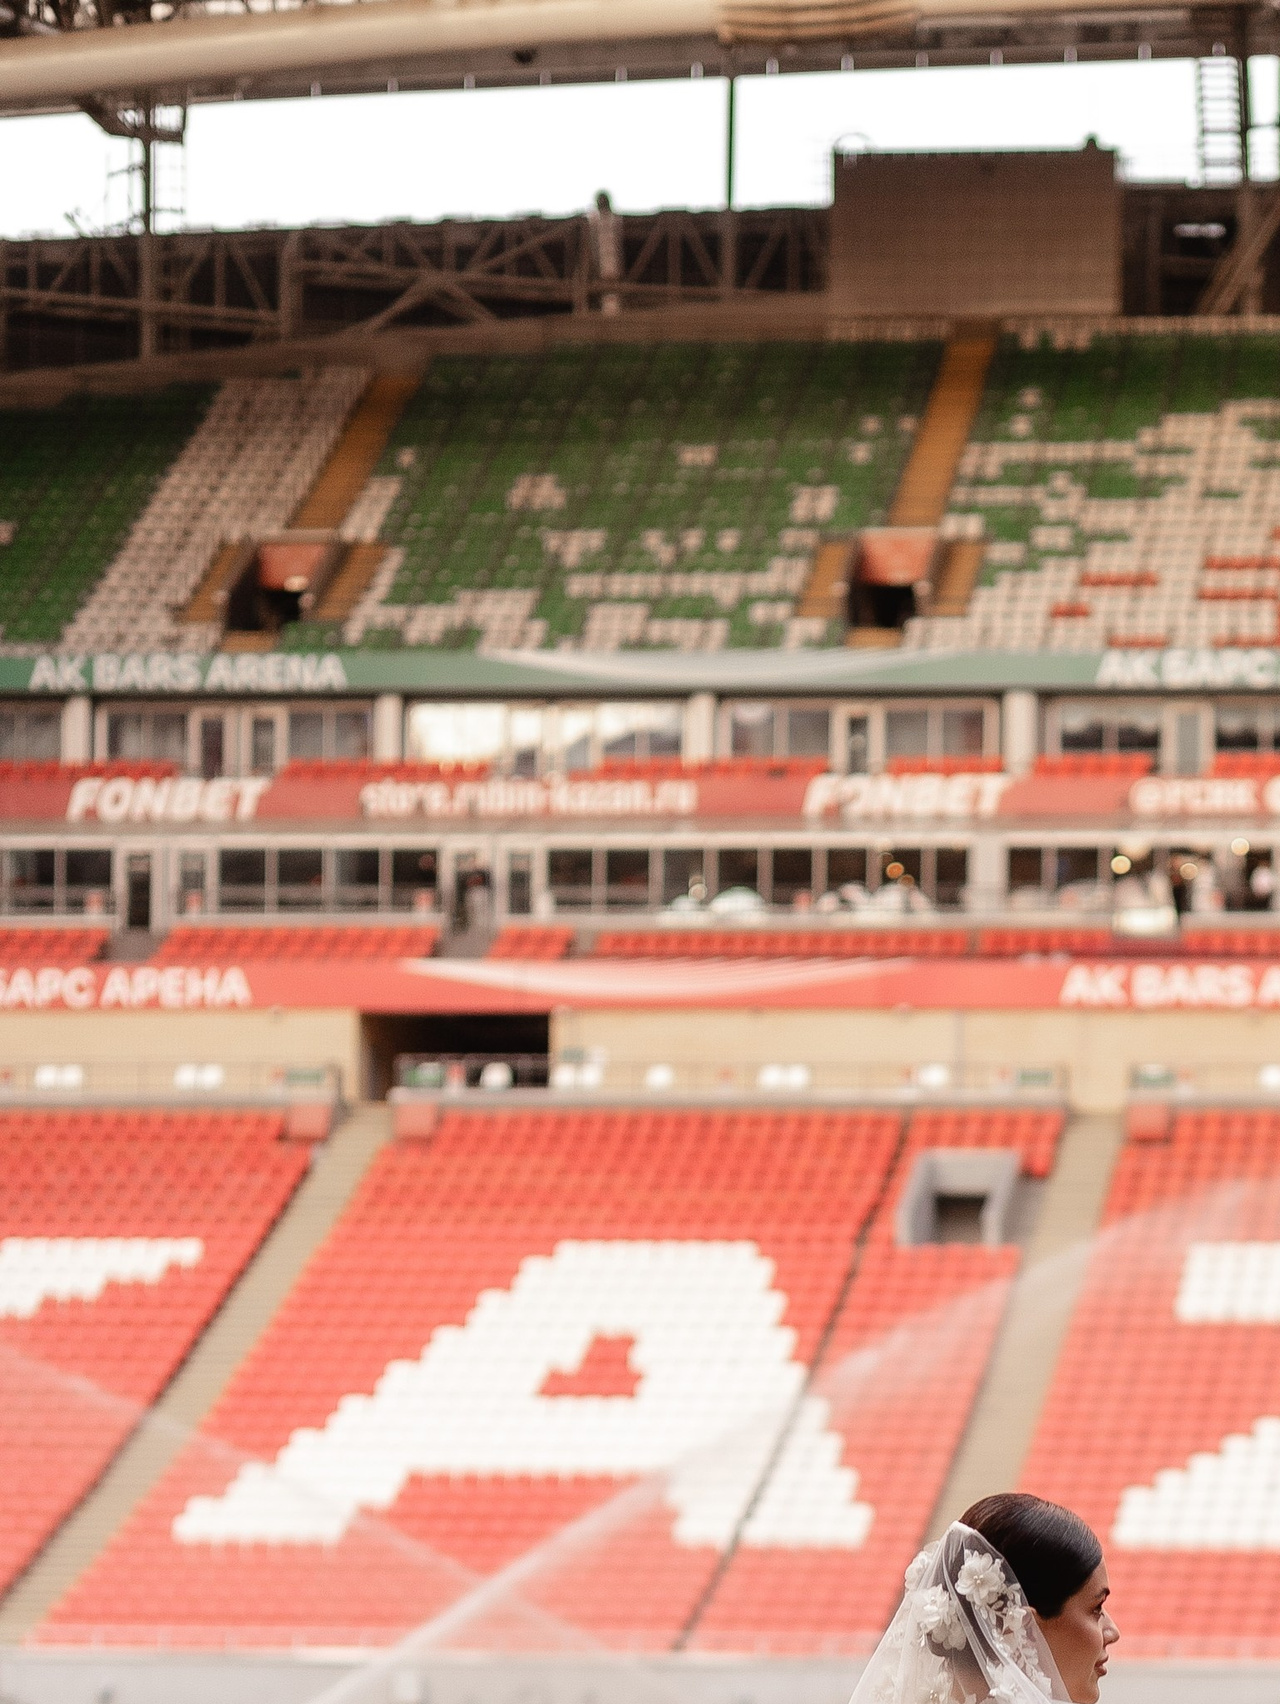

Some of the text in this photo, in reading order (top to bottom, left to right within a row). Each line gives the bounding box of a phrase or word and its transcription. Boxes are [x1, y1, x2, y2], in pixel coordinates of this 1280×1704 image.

[29, 654, 348, 692] AK BARS ARENA
[66, 776, 271, 822] FONBET
[0, 966, 251, 1008] АРС АРЕНА
[1060, 964, 1128, 1007] AK
[1129, 964, 1252, 1007] BARS
